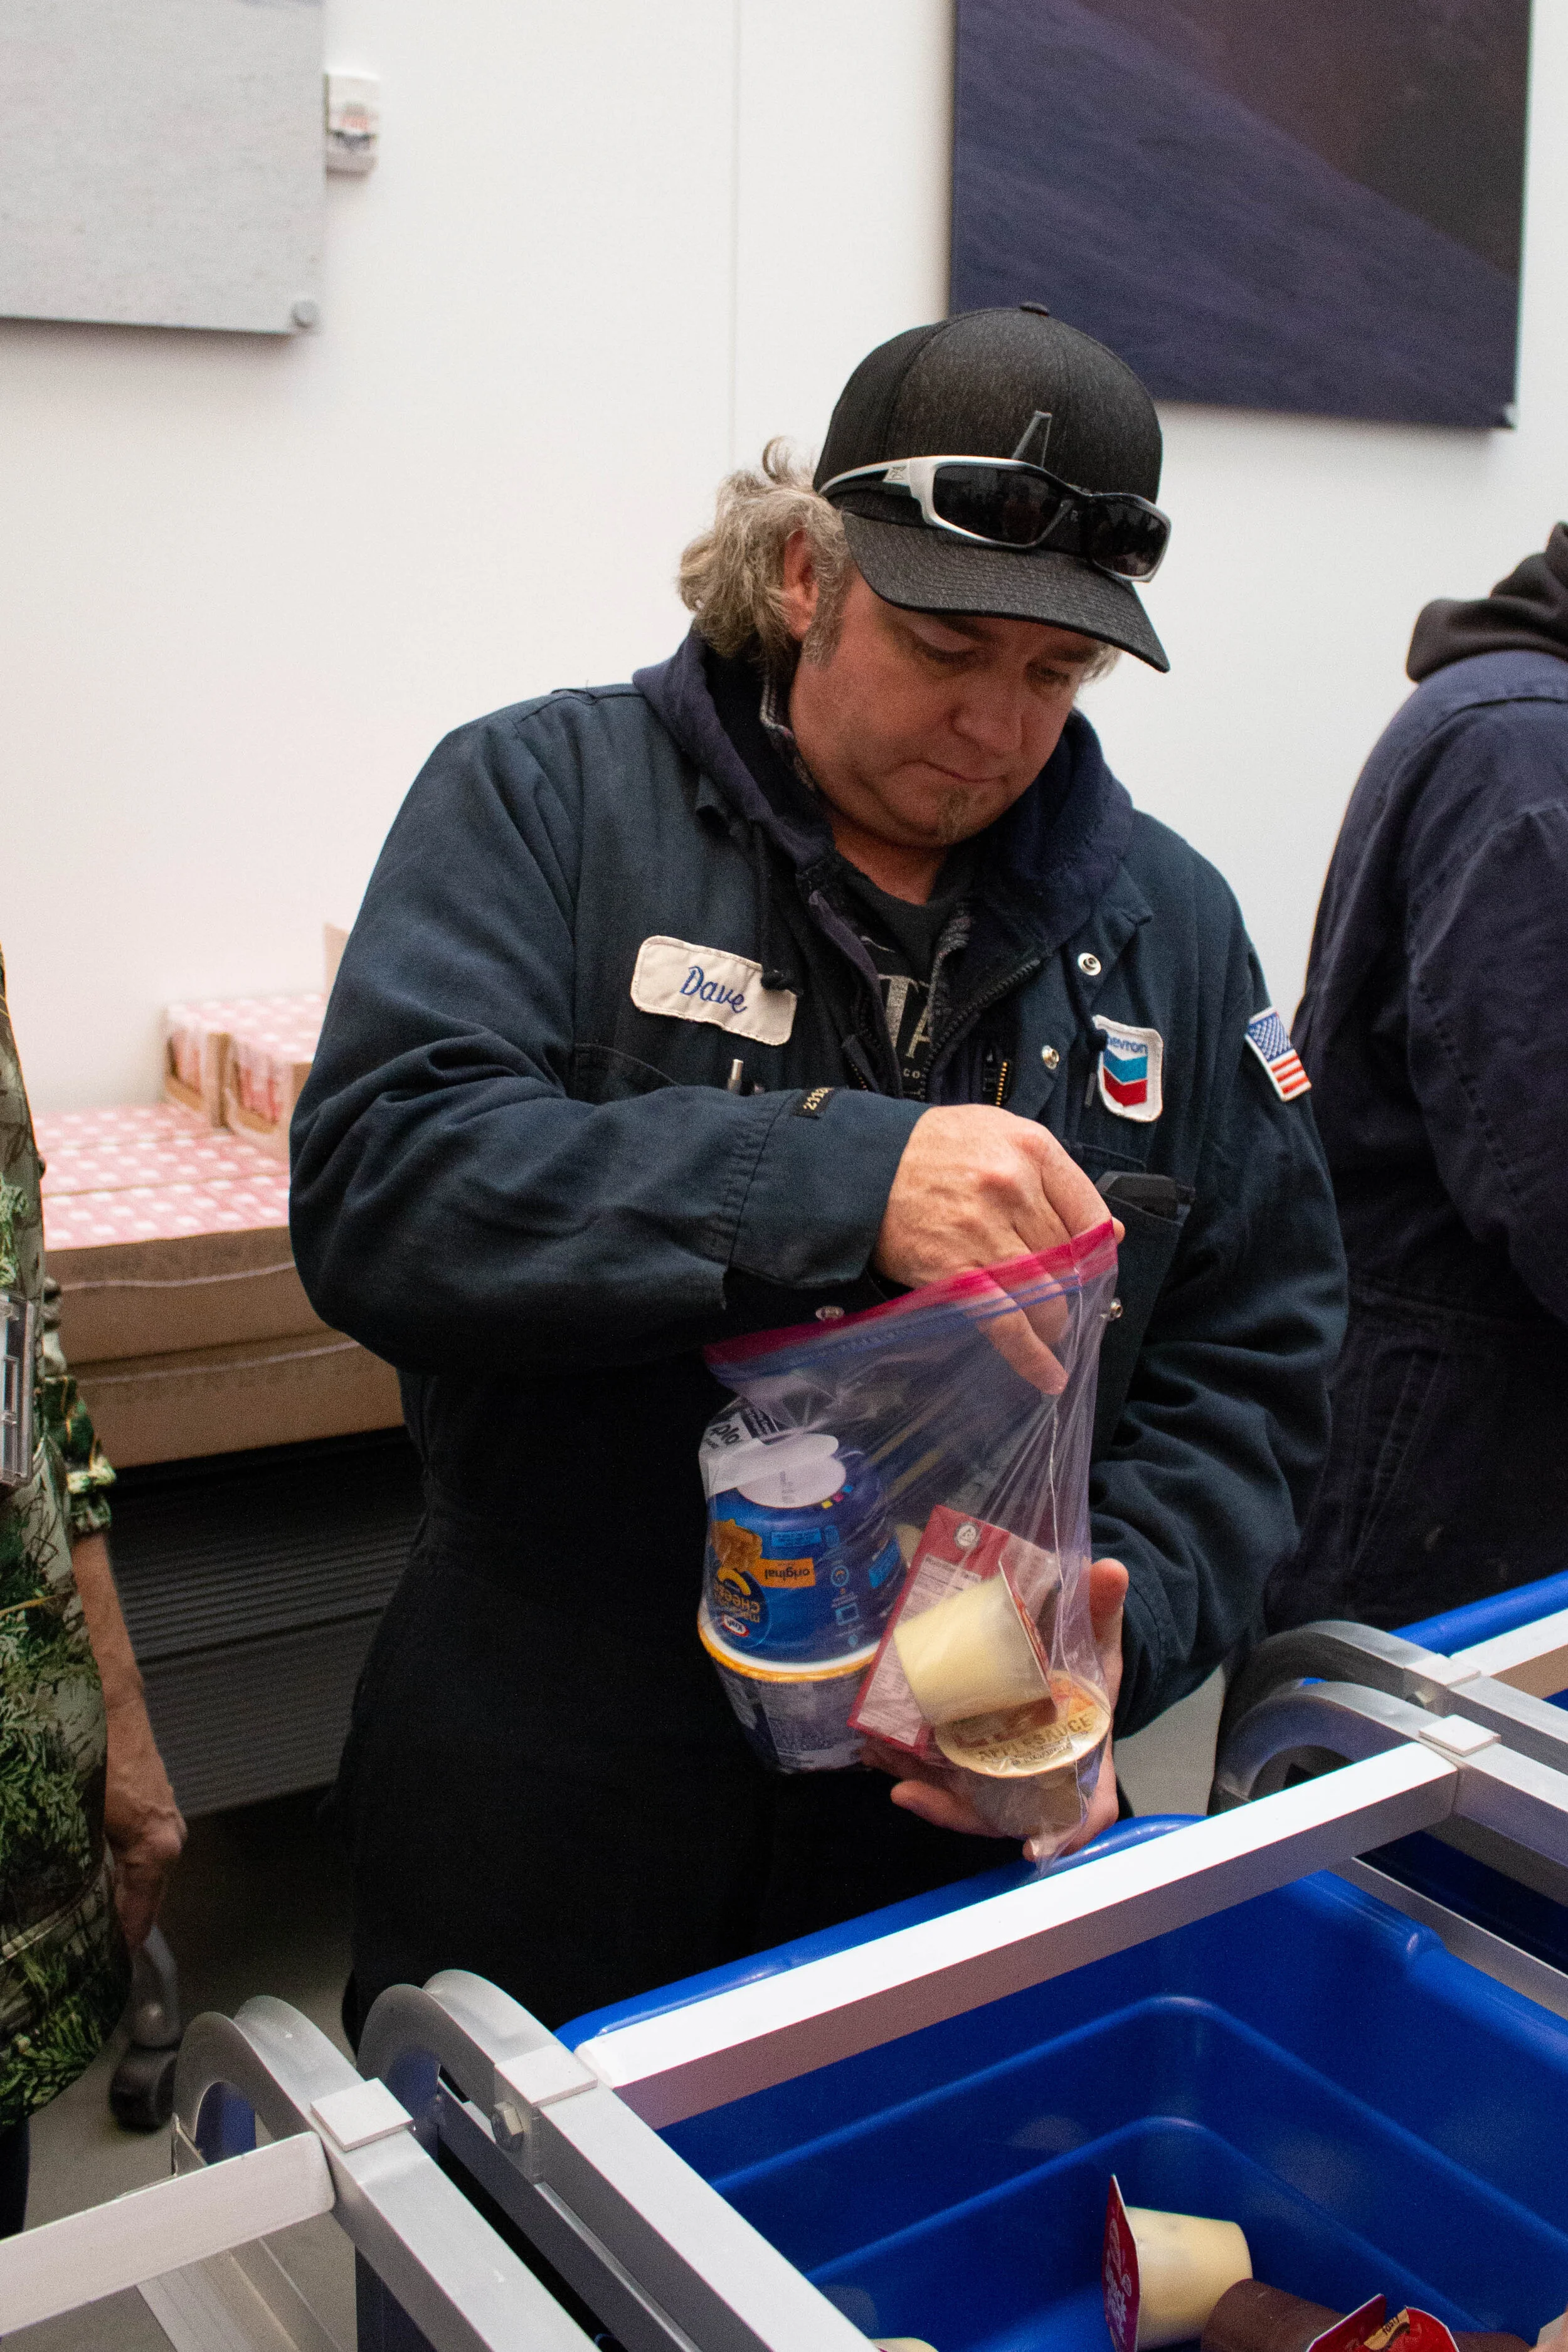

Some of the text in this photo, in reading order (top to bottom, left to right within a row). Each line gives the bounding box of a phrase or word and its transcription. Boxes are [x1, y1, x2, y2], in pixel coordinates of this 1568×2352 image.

[680, 965, 748, 1014] Dave
[1106, 1036, 1148, 1056] evron
[765, 1566, 811, 1581] original
